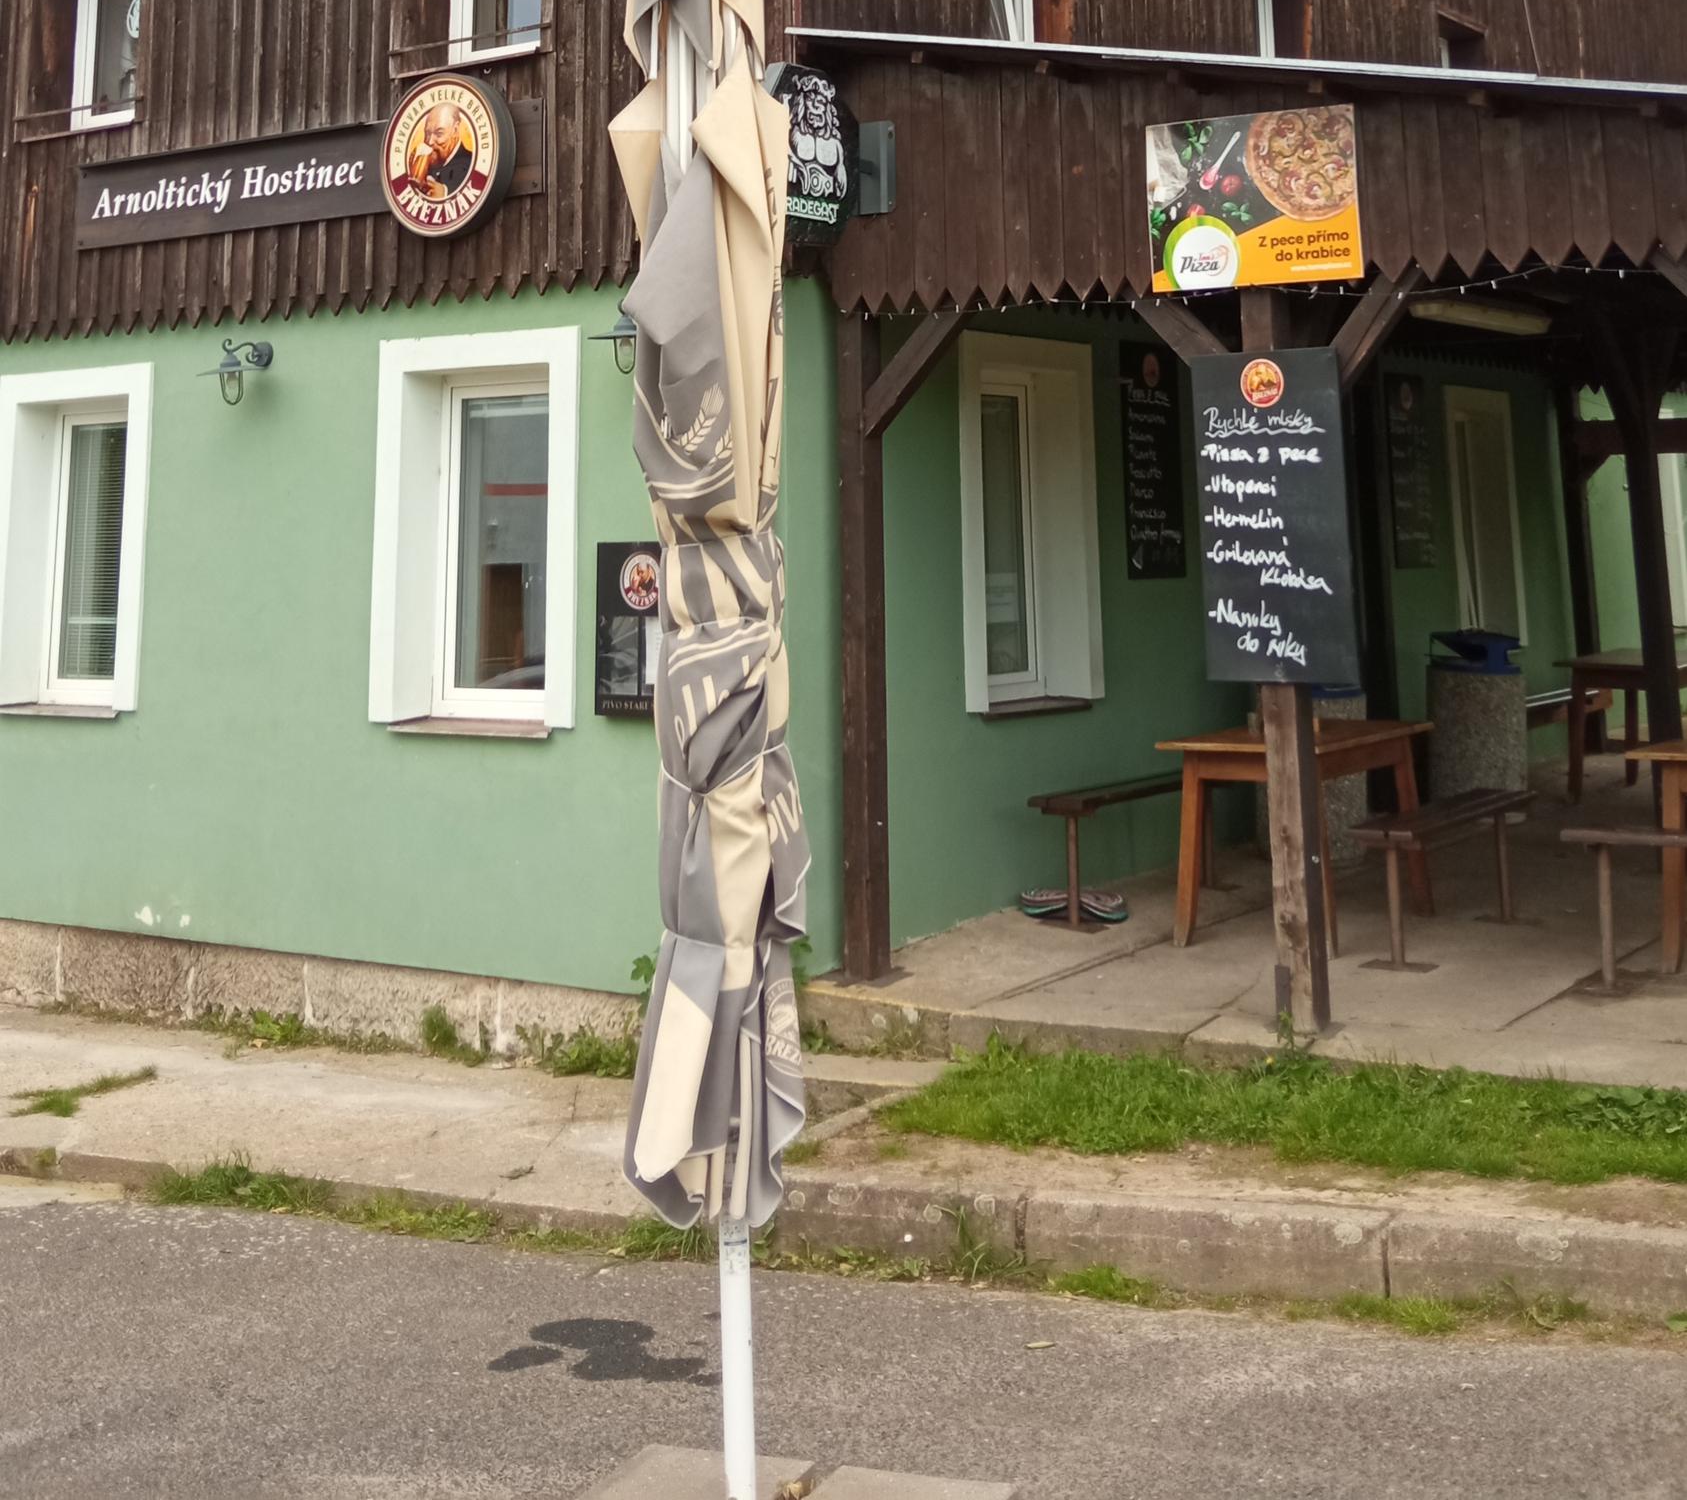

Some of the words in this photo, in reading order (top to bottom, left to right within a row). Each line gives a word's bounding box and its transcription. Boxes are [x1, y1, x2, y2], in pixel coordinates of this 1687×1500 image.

[394, 100, 427, 153] PIVOVAR
[430, 89, 464, 103] VELKÉ
[466, 101, 490, 150] BŘEZNO
[91, 168, 232, 219] Arnoltický
[240, 157, 365, 199] Hostinec
[396, 180, 481, 225] BŘEZŇÁK
[1270, 235, 1304, 249] pece
[1307, 230, 1349, 246] přímo
[1180, 256, 1220, 273] Pizza
[1275, 249, 1293, 262] do
[1296, 245, 1351, 260] krabice
[1203, 407, 1260, 438] Rychlé
[1267, 408, 1315, 435] mlsky
[1237, 631, 1260, 653] do
